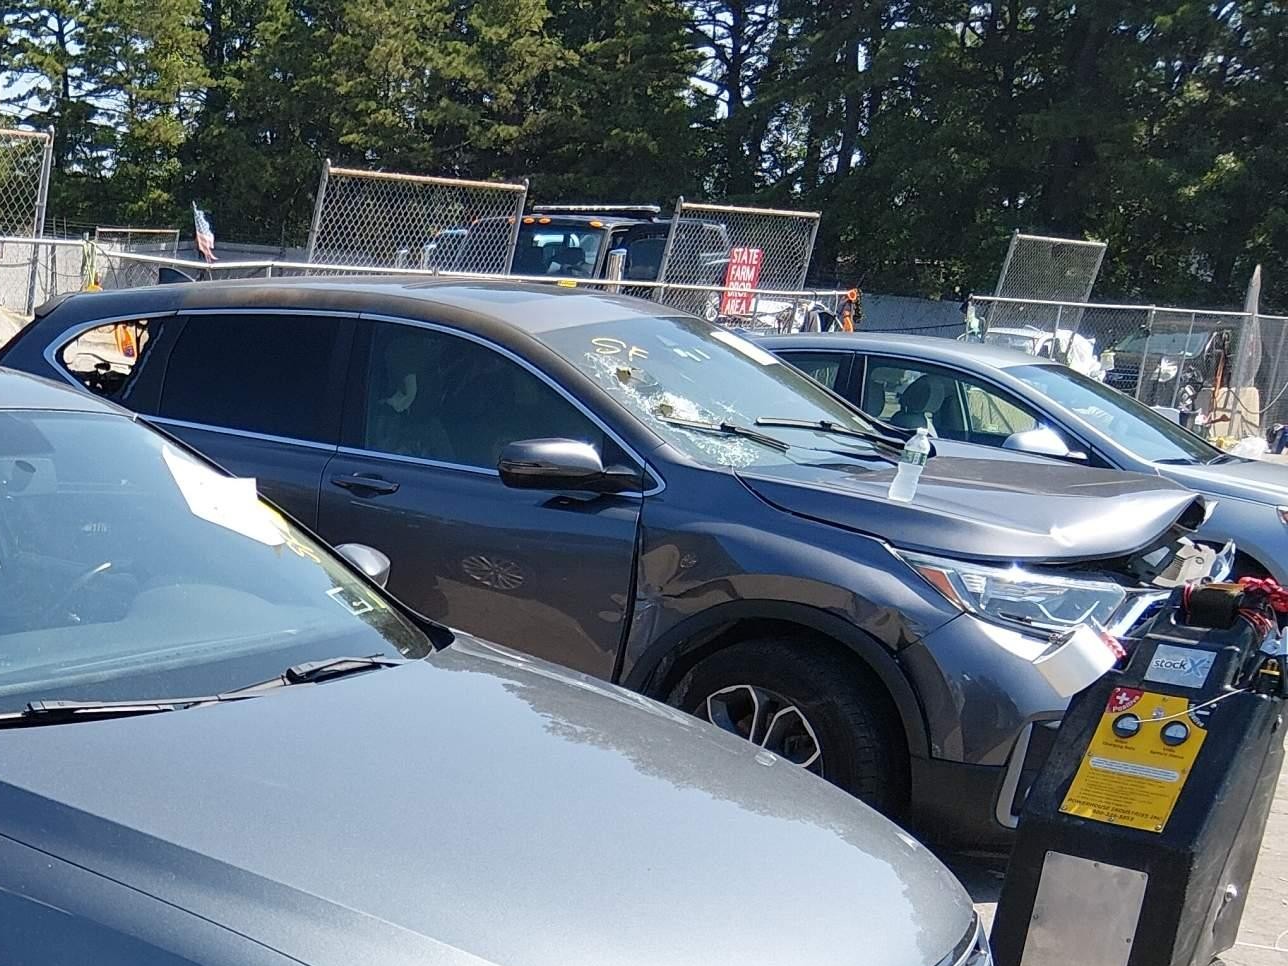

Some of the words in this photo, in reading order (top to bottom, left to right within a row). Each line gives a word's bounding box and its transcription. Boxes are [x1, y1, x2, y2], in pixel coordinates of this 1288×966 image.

[731, 247, 760, 265] STATE
[729, 265, 756, 282] FARM
[723, 298, 746, 315] AREA
[1153, 656, 1209, 678] stockX
